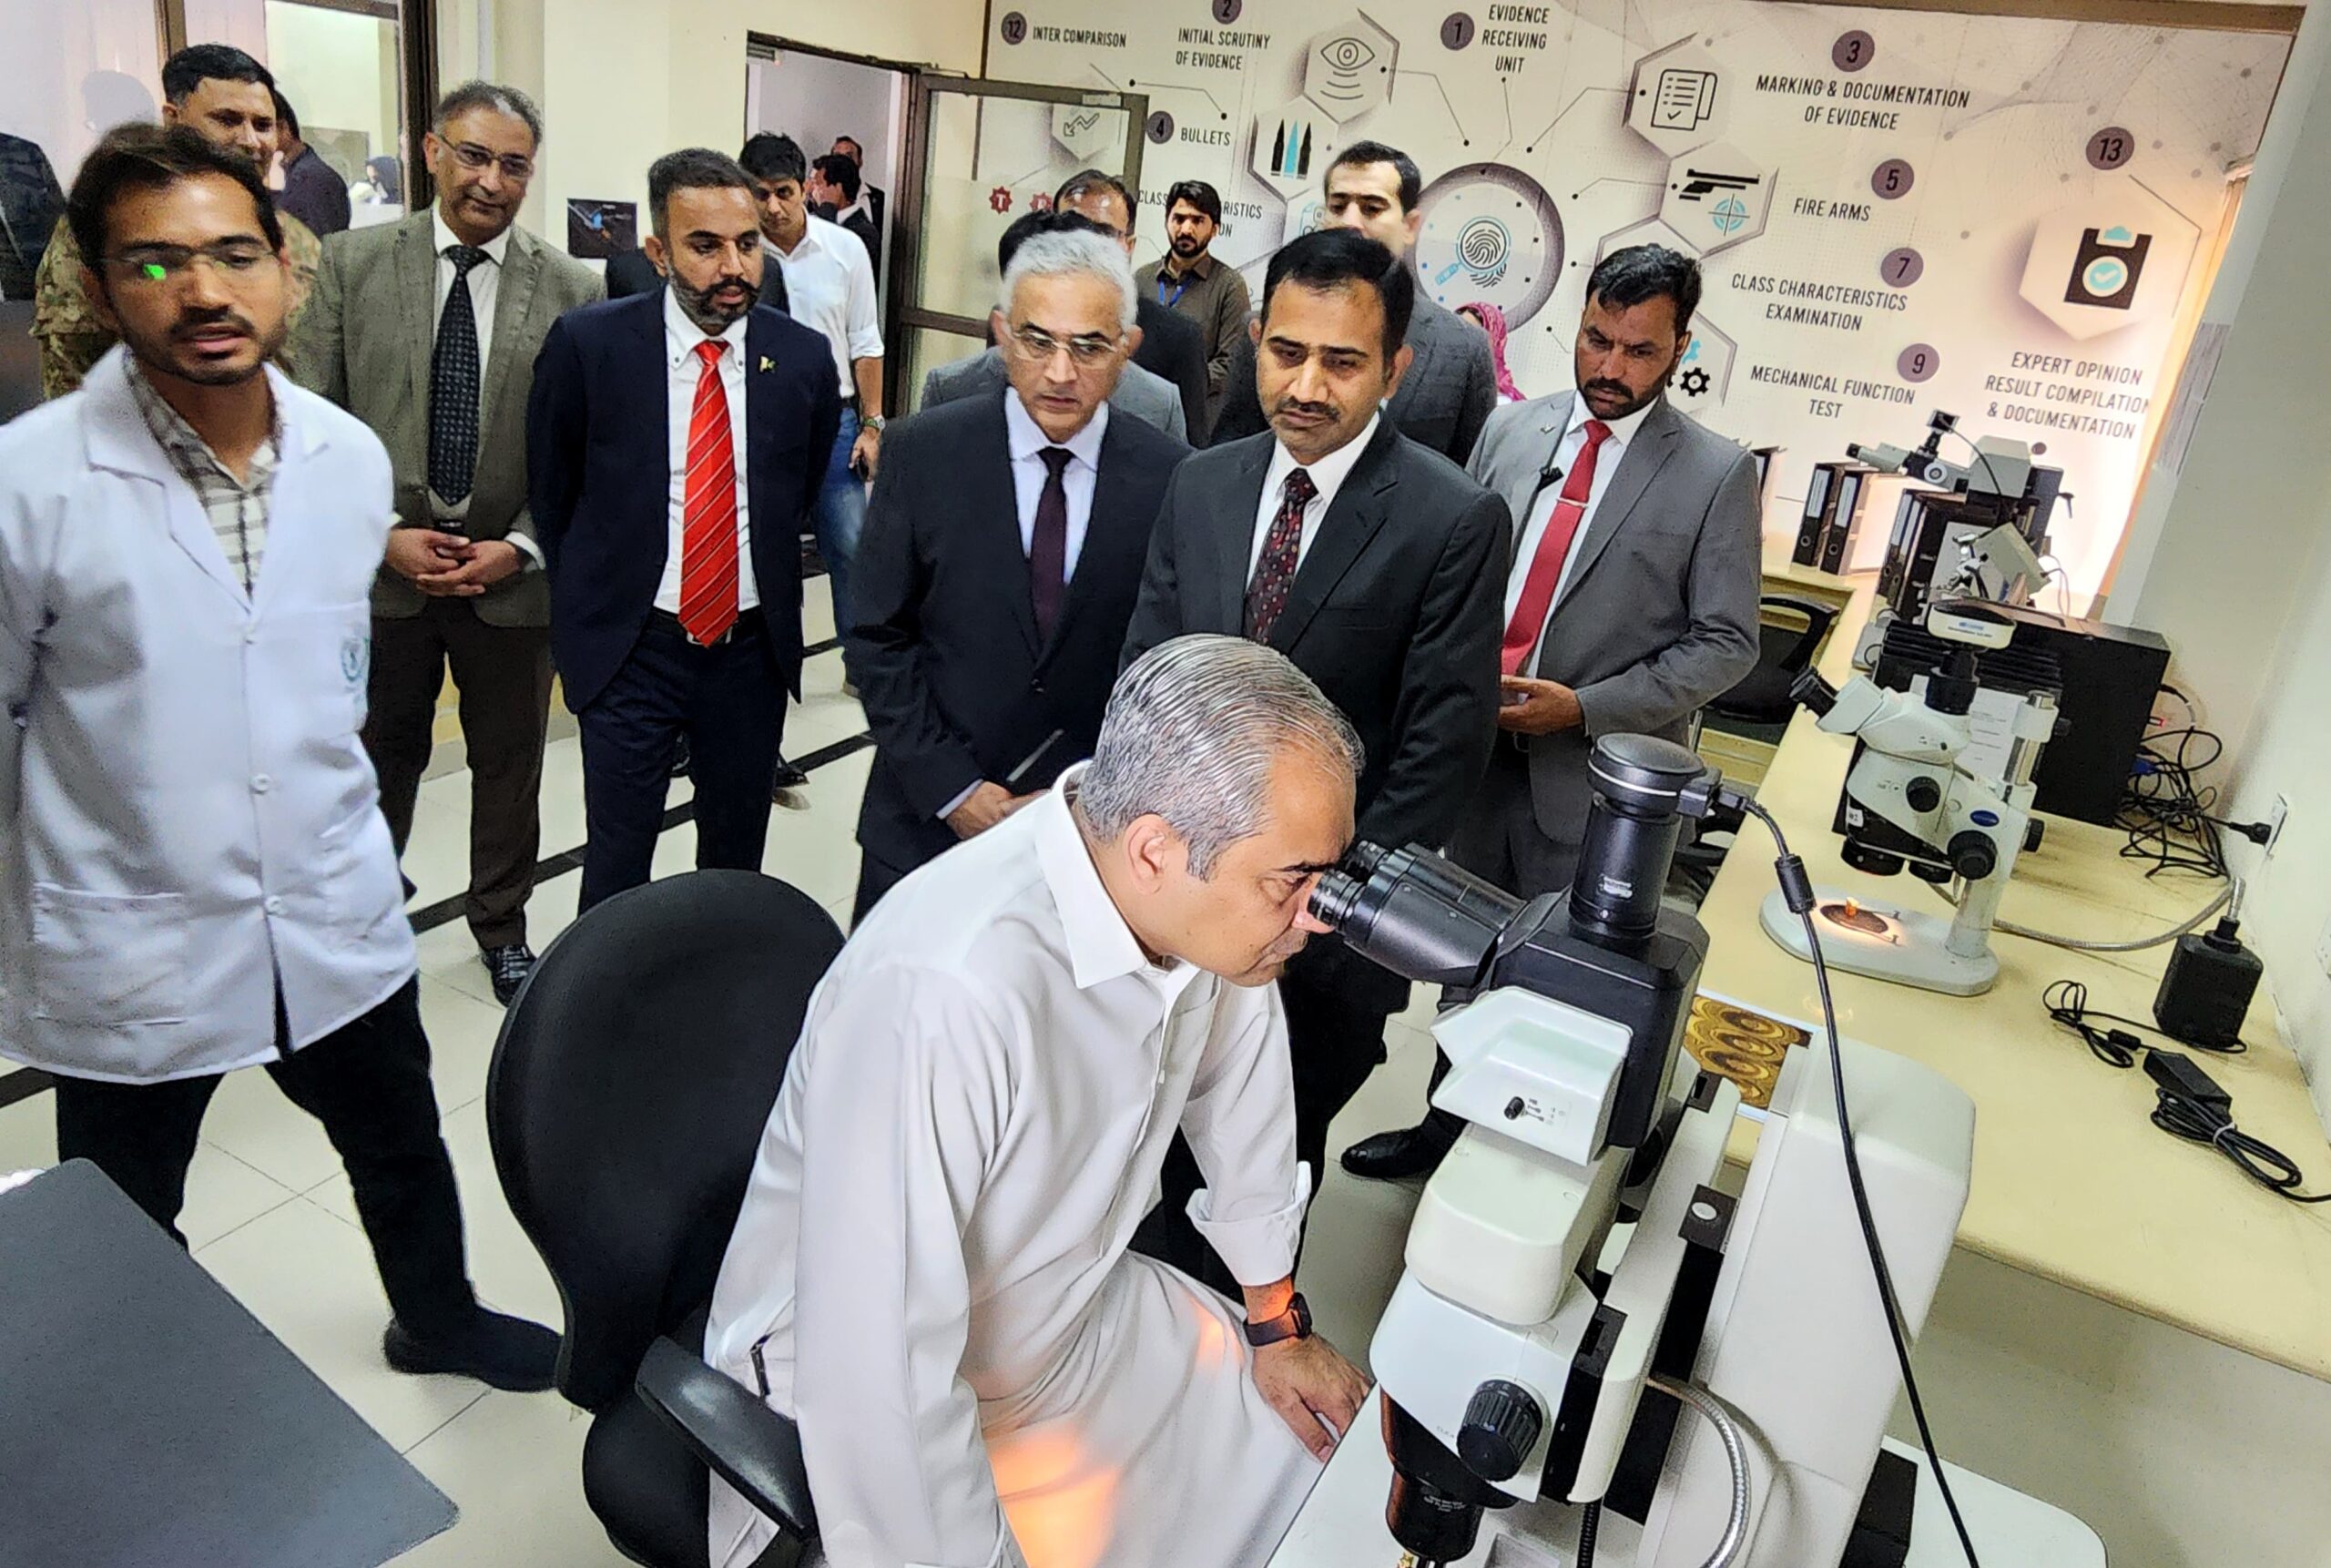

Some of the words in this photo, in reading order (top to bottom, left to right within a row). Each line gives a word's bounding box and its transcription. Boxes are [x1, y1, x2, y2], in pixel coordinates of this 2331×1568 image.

[1222, 0, 1231, 17] 2
[1489, 4, 1550, 24] EVIDENCE
[1008, 19, 1021, 39] 12
[1033, 25, 1061, 42] INTER
[1064, 28, 1126, 47] COMPARISON
[1178, 28, 1215, 46] INITIAL
[1218, 30, 1270, 49] SCRUTINY
[1454, 22, 1463, 43] 1
[1481, 29, 1547, 49] RECEIVING
[1176, 51, 1188, 66] OF
[1192, 53, 1242, 70] EVIDENCE
[1847, 40, 1860, 64] 3
[1495, 56, 1525, 74] UNIT
[1756, 75, 1824, 97] MARKING
[1827, 80, 1837, 97] &
[1842, 81, 1970, 108] DOCUMENTATION
[1156, 117, 1165, 136] 4
[1805, 106, 1822, 123] OF
[1827, 107, 1900, 130] EVIDENCE
[1181, 127, 1230, 146] BULLETS
[2099, 137, 2122, 162] 13
[1886, 169, 1899, 191] 5
[1138, 189, 1168, 207] CLASS
[1793, 198, 1826, 218] FIRE
[1828, 201, 1871, 221] ARMS
[1897, 257, 1910, 280] 7
[1732, 273, 1775, 293] CLASS
[1778, 280, 1909, 311] CHARACTERISTICS
[1766, 303, 1863, 331] EXAMINATION
[1912, 353, 1926, 374] 9
[2011, 351, 2072, 375] EXPERT
[2075, 361, 2143, 385] OPINION
[1750, 365, 1838, 394] MECHANICAL
[1843, 379, 1916, 405] FUNCTION
[1984, 374, 2042, 398] RESULT
[1809, 399, 1843, 419] TEST
[1987, 402, 1999, 417] &
[2004, 404, 2136, 439] DOCUMENTATION
